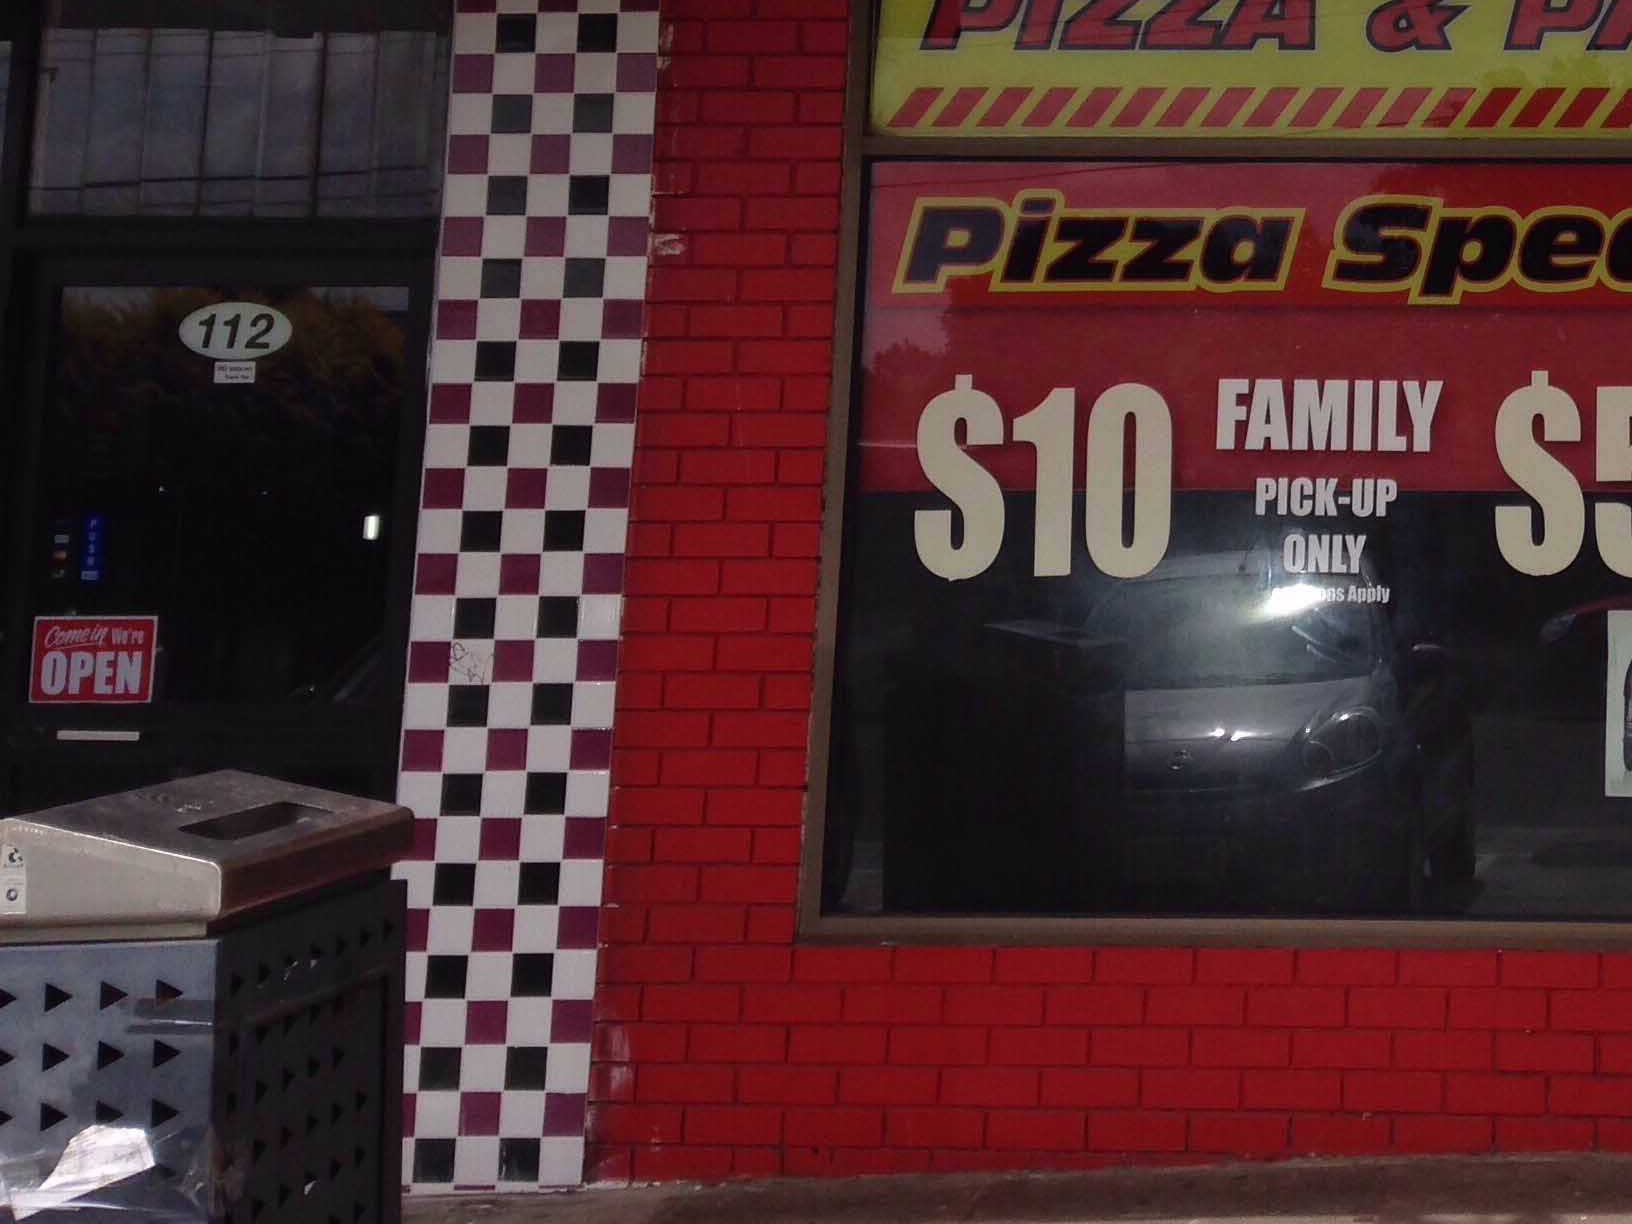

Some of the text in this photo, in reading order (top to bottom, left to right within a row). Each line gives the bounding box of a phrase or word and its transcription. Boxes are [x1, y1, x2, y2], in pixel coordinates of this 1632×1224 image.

[893, 189, 1305, 294] Pizza
[198, 312, 275, 350] 112
[1216, 378, 1444, 453] FAMILY
[914, 374, 1173, 581] $10
[1255, 477, 1398, 517] PICK-UP
[1283, 534, 1367, 574] ONLY
[1347, 584, 1391, 604] Apply
[41, 650, 143, 696] OPEN
